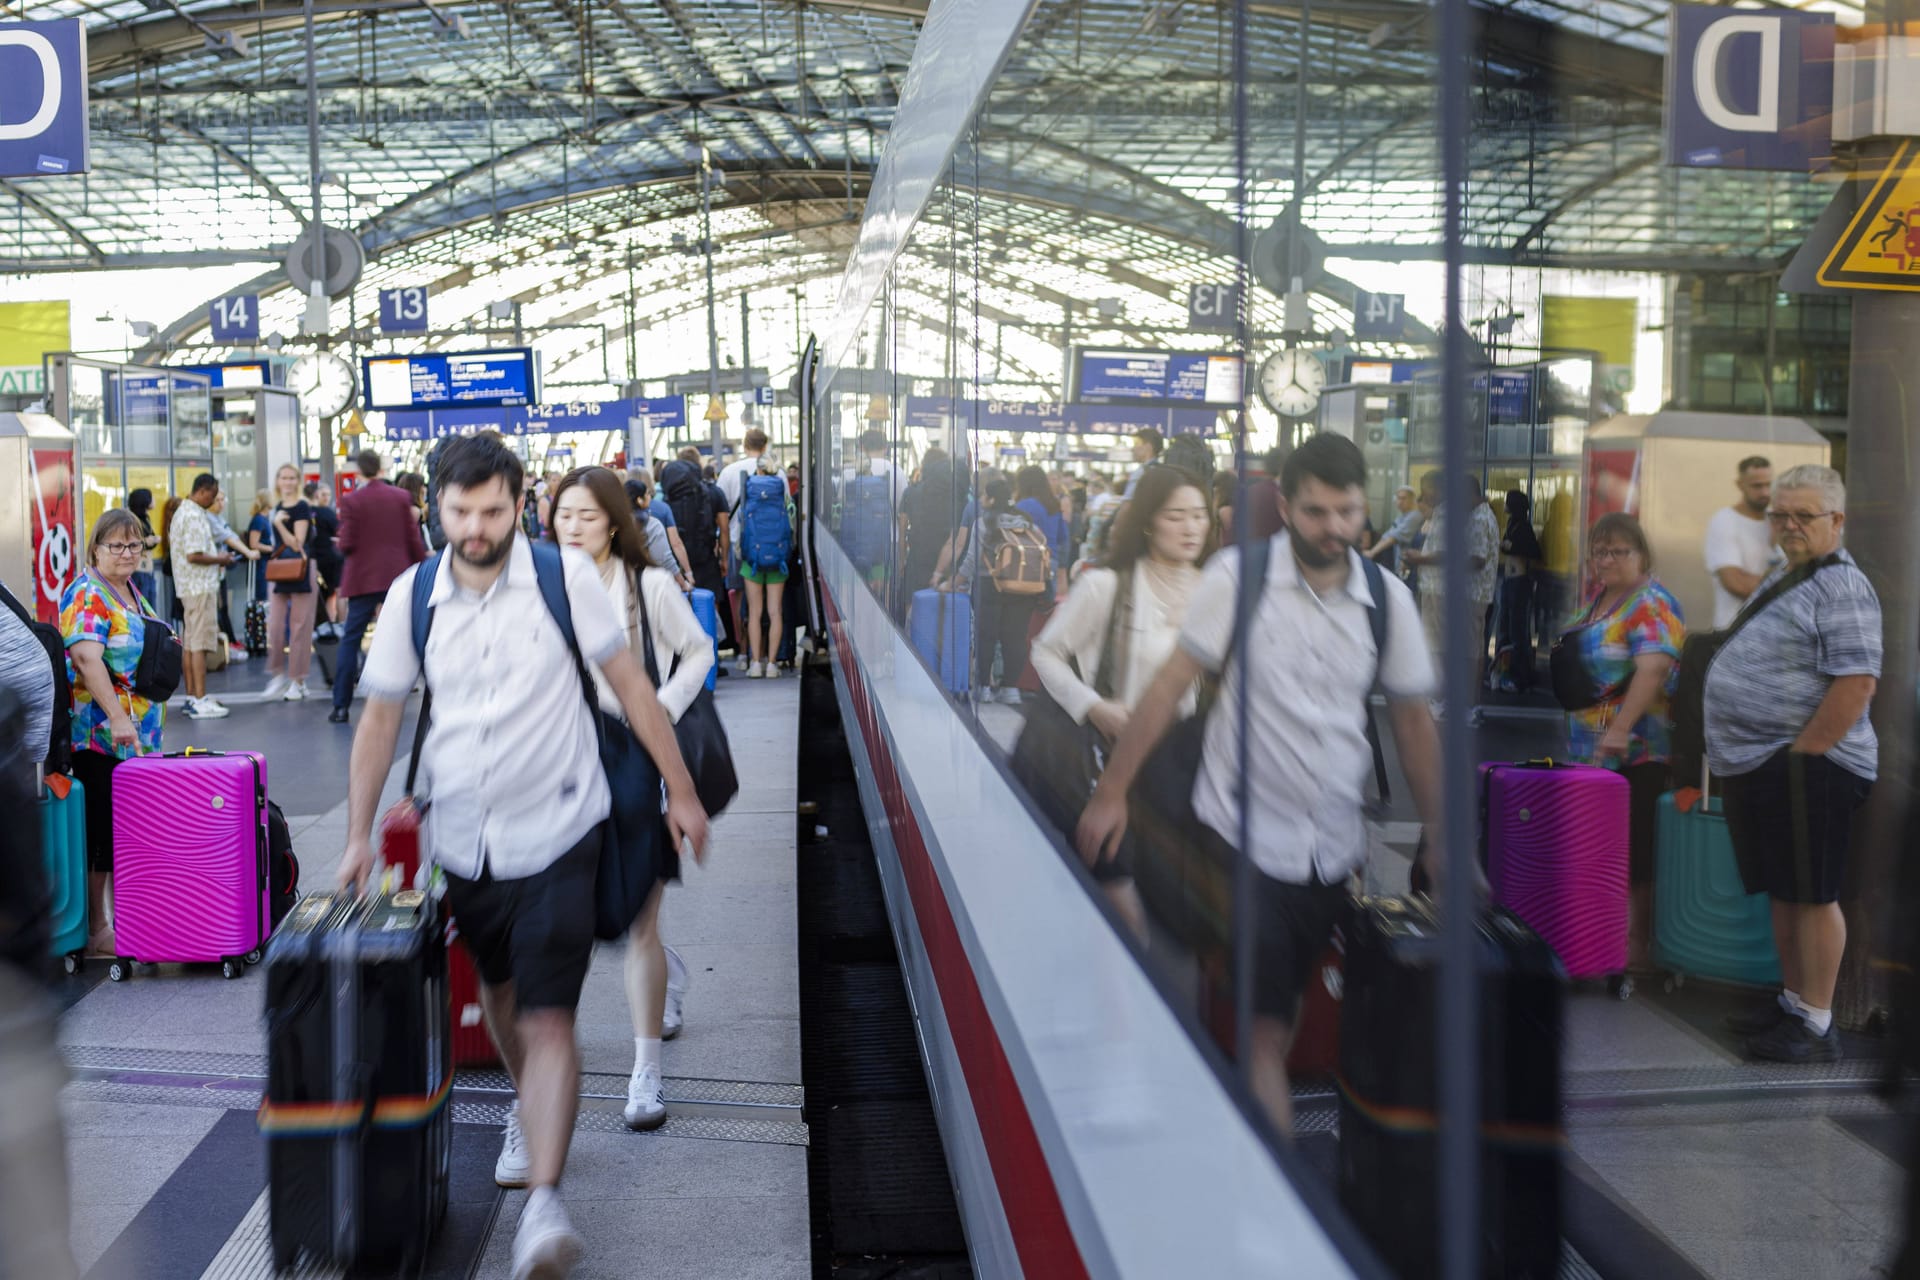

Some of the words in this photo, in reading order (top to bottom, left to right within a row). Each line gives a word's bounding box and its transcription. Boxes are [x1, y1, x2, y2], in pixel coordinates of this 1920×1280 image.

[0, 29, 62, 140] D
[214, 296, 249, 329] 14
[388, 288, 424, 320] 13
[526, 404, 553, 418] 1-12
[565, 402, 601, 417] 15-16
[762, 386, 774, 404] E
